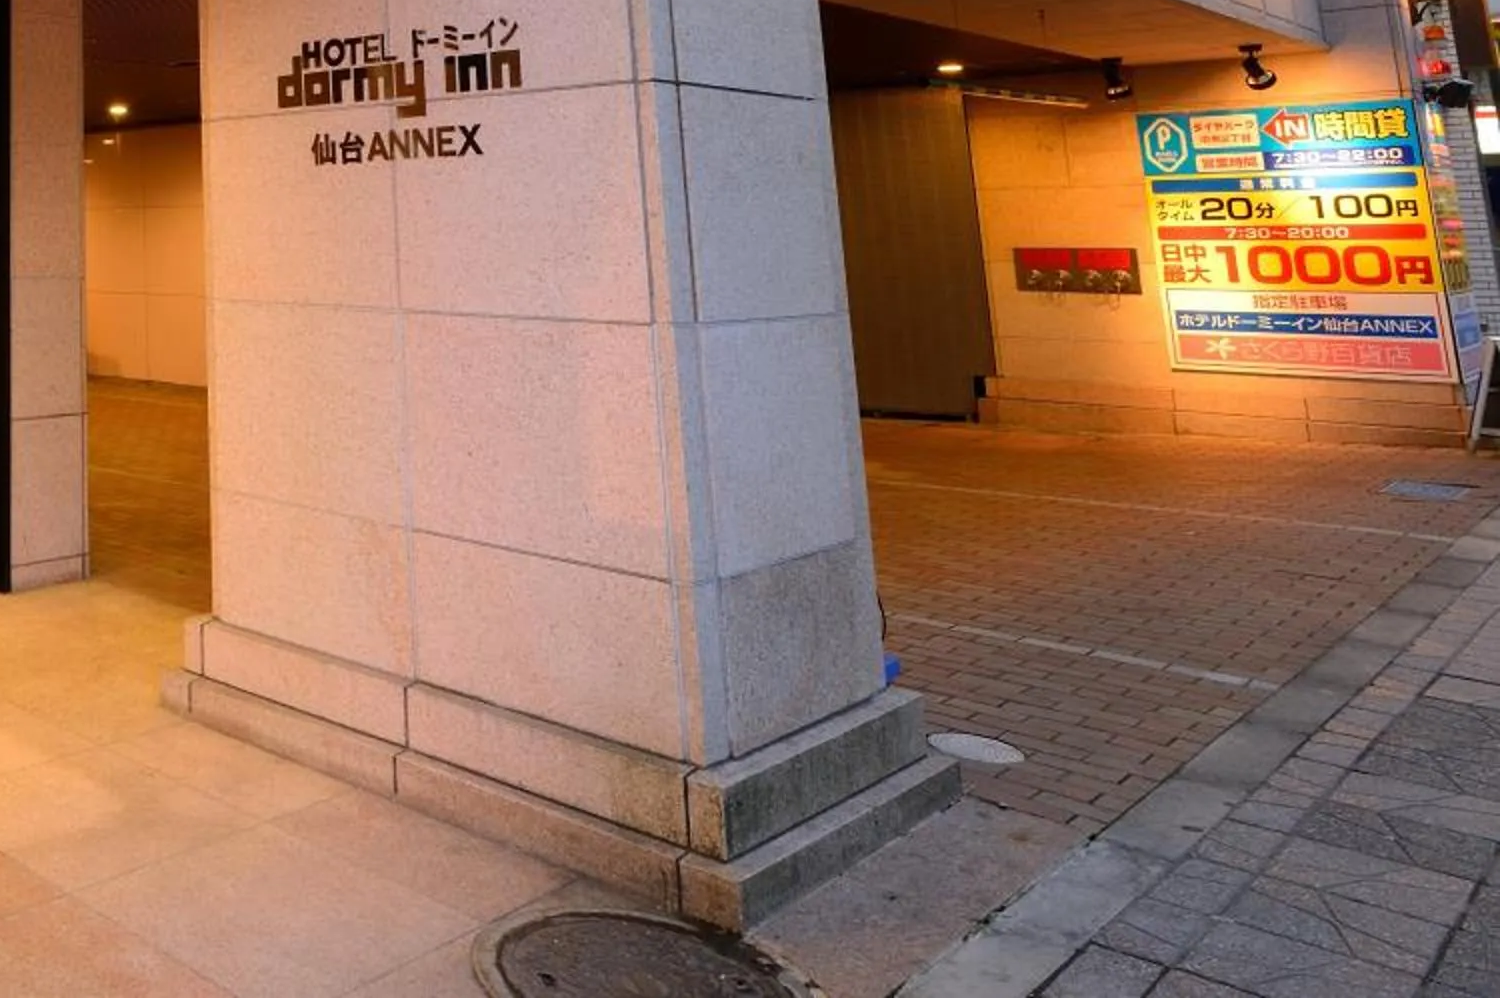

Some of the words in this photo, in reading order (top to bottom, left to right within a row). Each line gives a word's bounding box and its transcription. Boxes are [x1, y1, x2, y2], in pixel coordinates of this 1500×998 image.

[302, 33, 398, 69] HOTEL
[411, 17, 518, 58] ドーミーイン
[277, 55, 427, 118] dormy
[444, 49, 522, 94] inn
[1274, 118, 1306, 138] IN
[1313, 107, 1409, 141] 時間貸
[311, 123, 484, 166] 仙台ANNEX
[1161, 243, 1207, 263] 日中
[1215, 244, 1435, 285] 1000円
[1163, 264, 1211, 284] 最大
